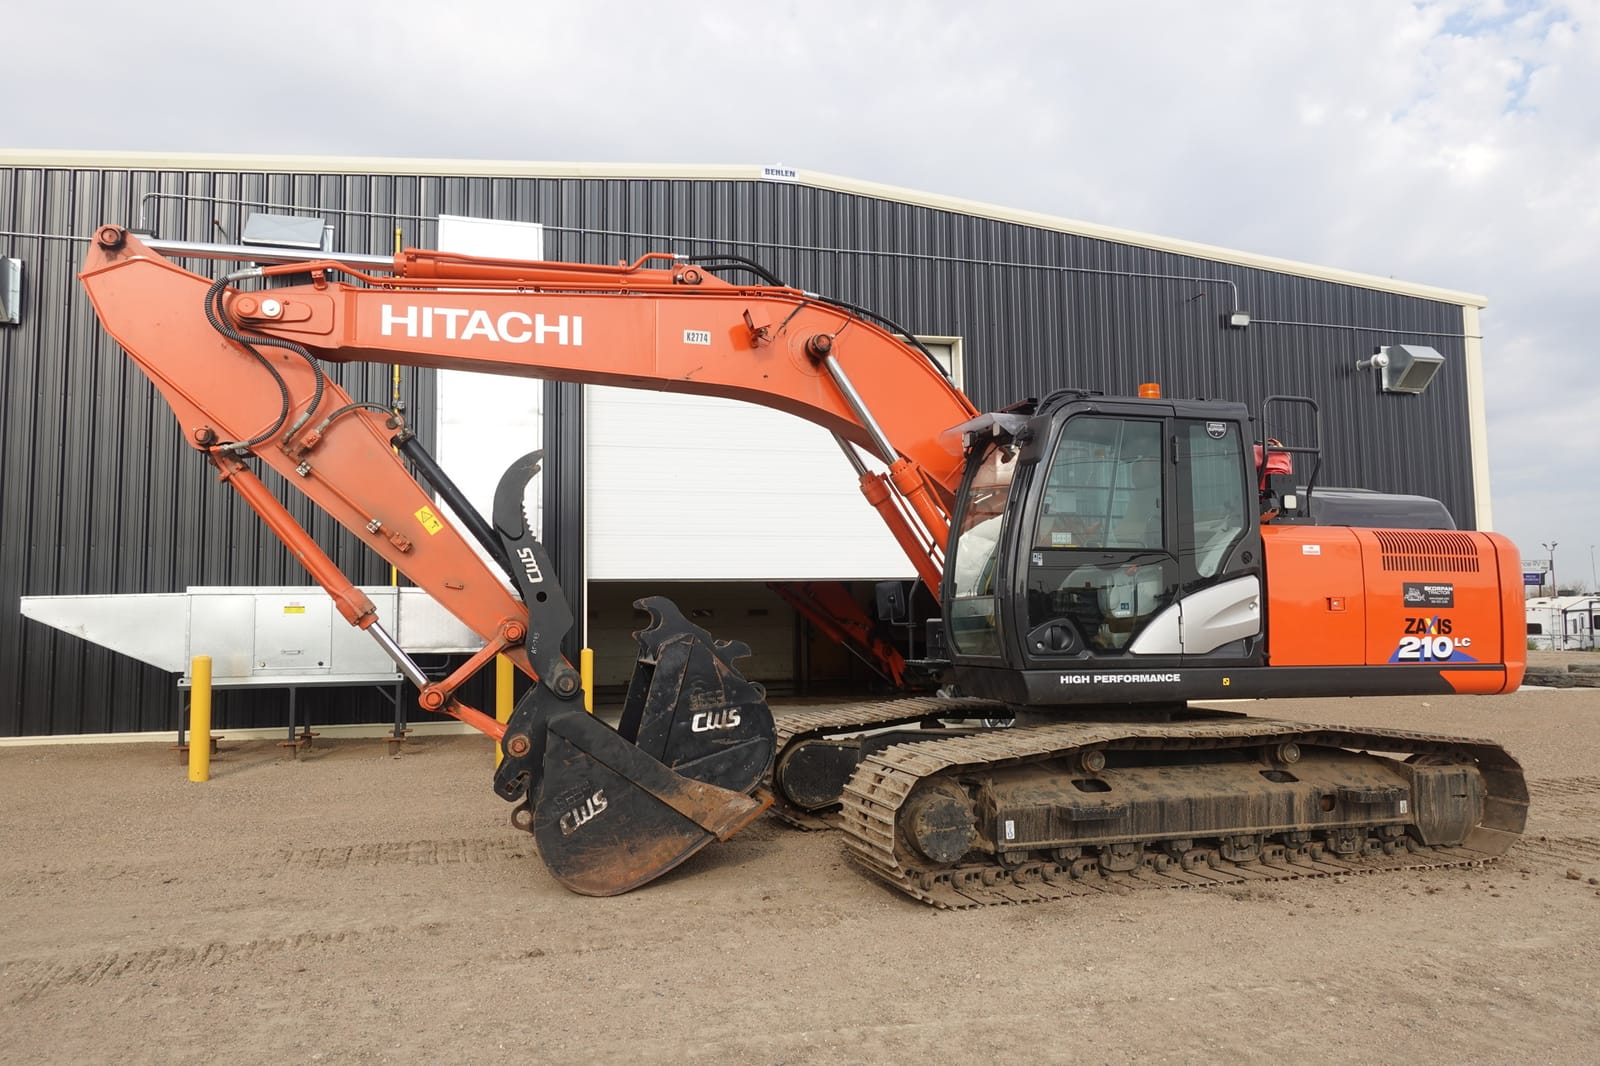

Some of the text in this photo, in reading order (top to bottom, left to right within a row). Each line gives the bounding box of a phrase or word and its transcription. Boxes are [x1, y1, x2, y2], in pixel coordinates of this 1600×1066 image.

[765, 168, 796, 178] BEHLEN
[381, 304, 583, 346] HITACHI
[686, 331, 708, 344] K2774
[1404, 615, 1452, 635] ZAXIS
[1398, 636, 1471, 661] 210 LC
[1060, 674, 1181, 684] HIGH PERFORMANCE
[691, 708, 741, 733] CWS
[560, 789, 608, 836] CWS
